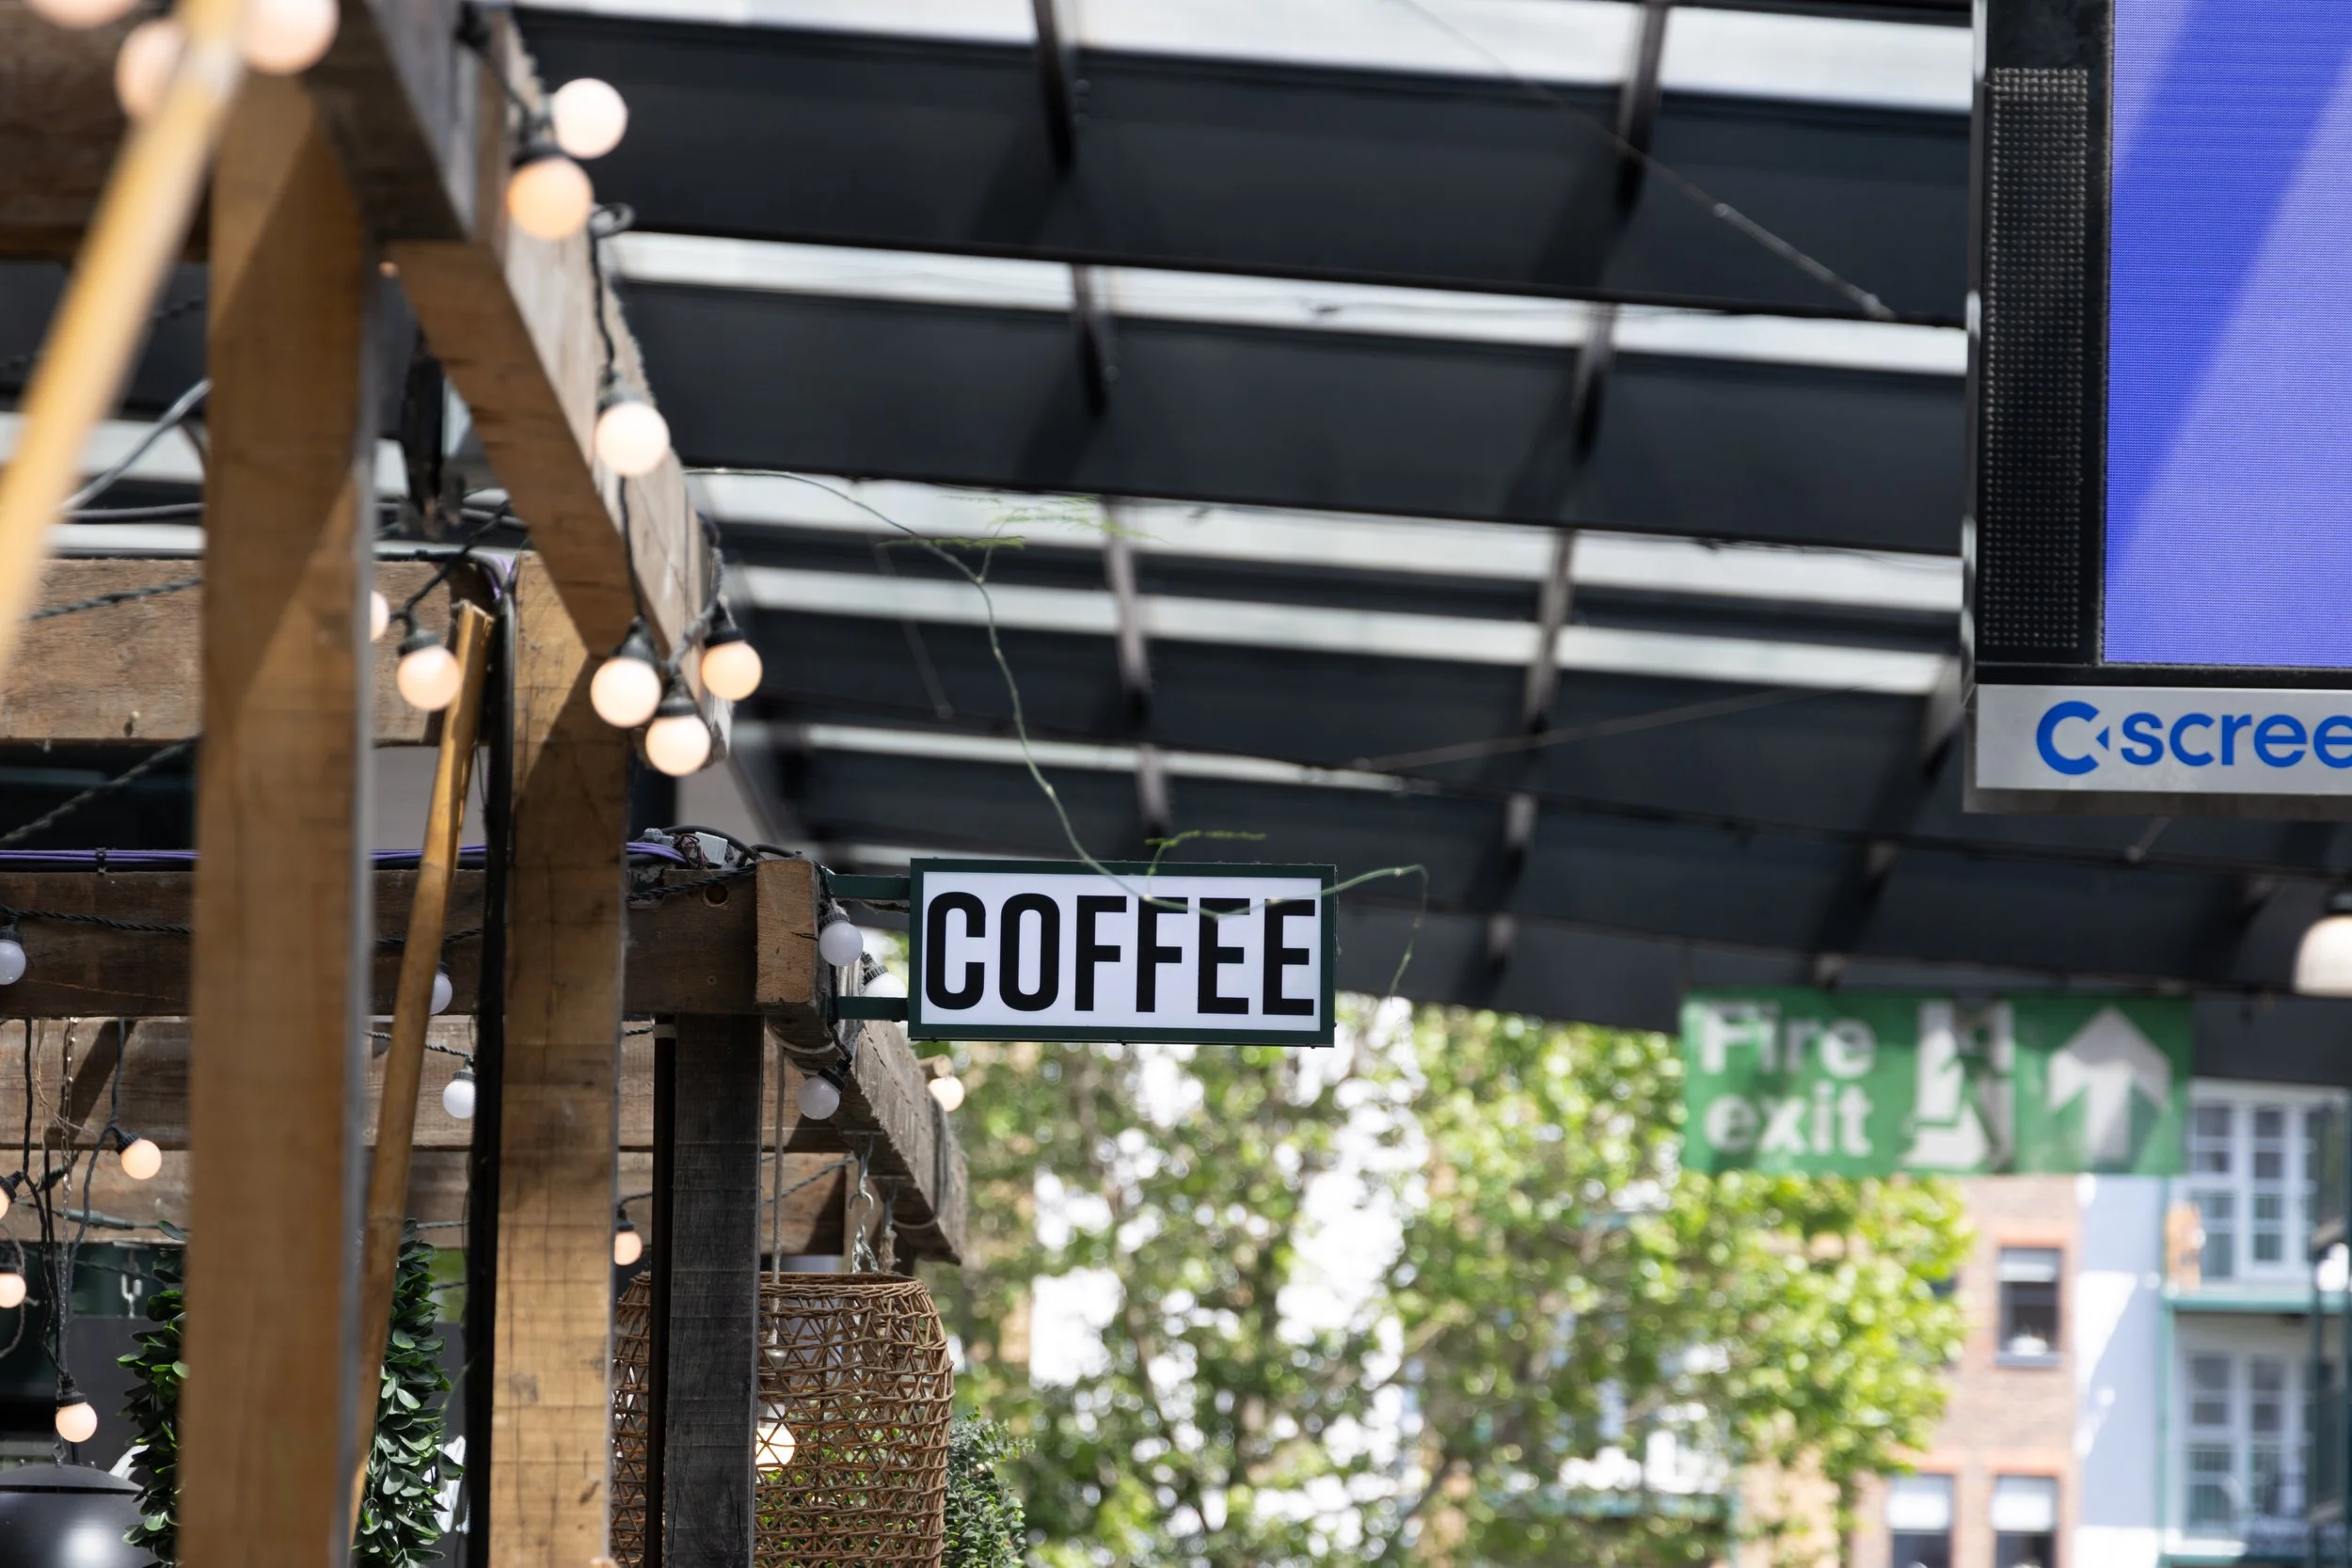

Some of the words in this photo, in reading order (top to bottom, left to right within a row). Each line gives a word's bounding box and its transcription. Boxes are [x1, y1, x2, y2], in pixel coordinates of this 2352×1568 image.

[926, 892, 1315, 1016] COFFEE
[1701, 1001, 1877, 1078] Fire
[1704, 1081, 1873, 1156] exit
